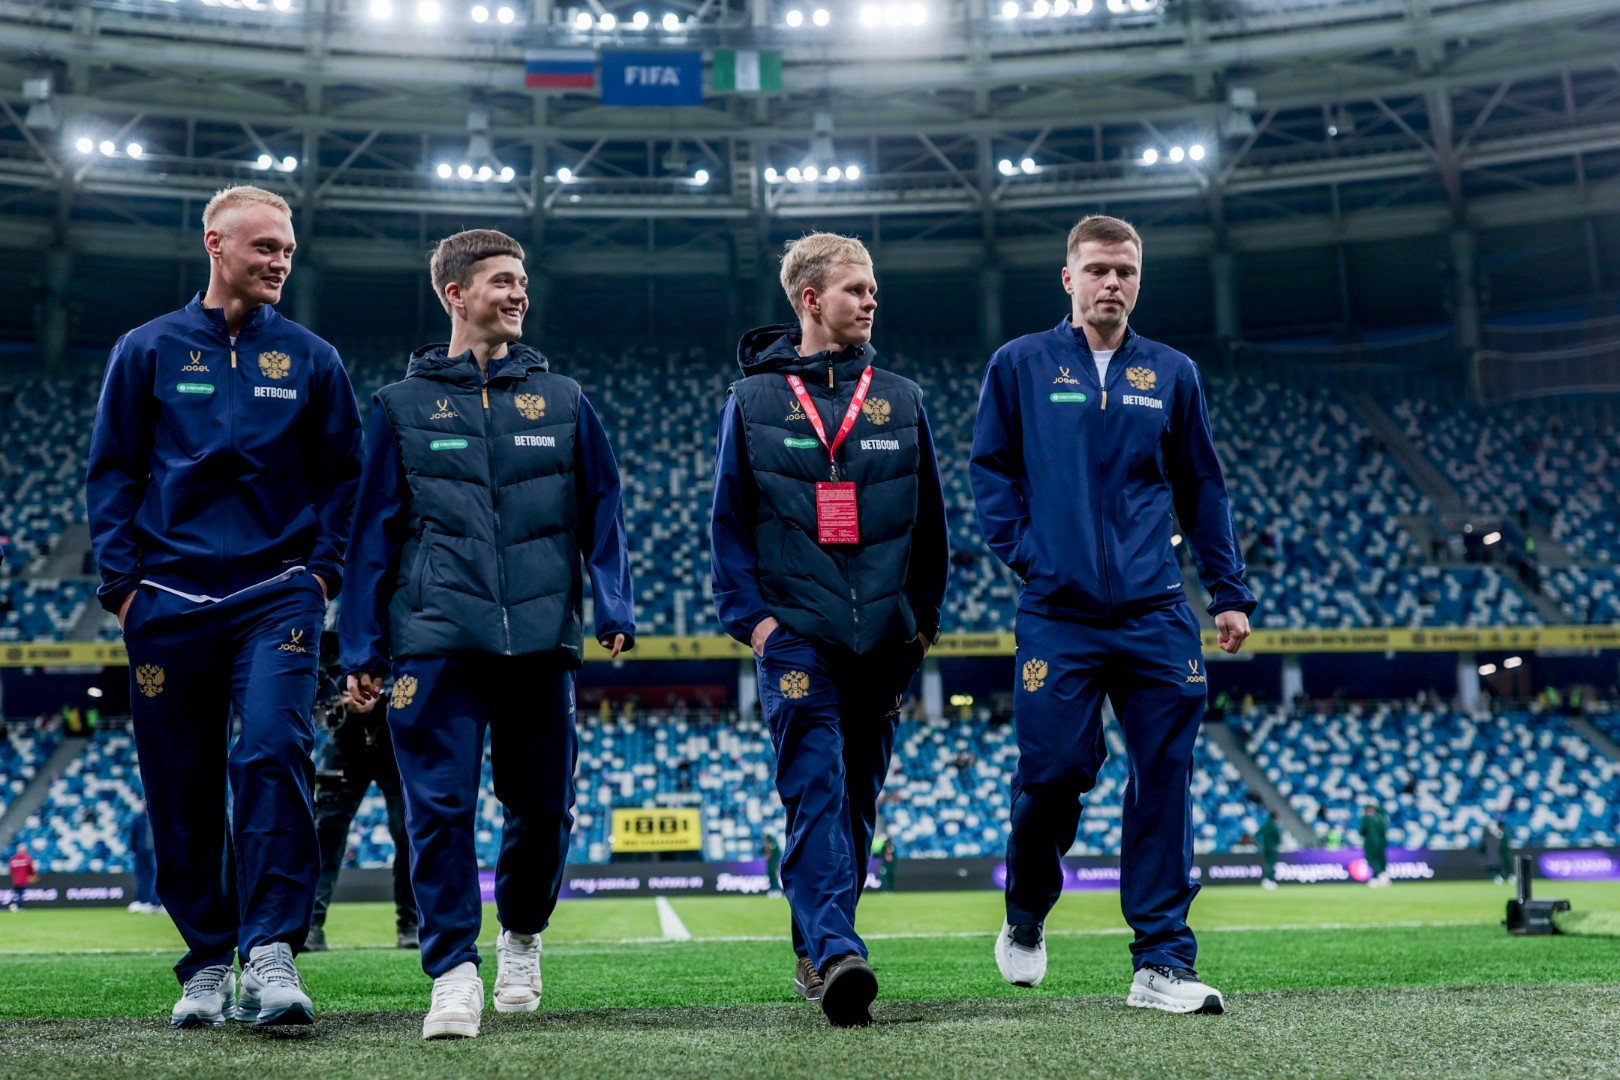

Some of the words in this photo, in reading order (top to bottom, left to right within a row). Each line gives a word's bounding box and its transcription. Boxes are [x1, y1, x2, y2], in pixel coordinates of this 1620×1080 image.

[624, 66, 680, 86] FIFA
[1053, 377, 1080, 385] JOGEL
[254, 386, 297, 400] BETBOOM
[1122, 394, 1163, 409] BETBOOM
[429, 411, 459, 420] JOGEL
[785, 413, 806, 421] JOGE
[514, 435, 556, 447] BETBOOM
[860, 439, 900, 450] BETBOOM
[1185, 675, 1205, 683] JOGE
